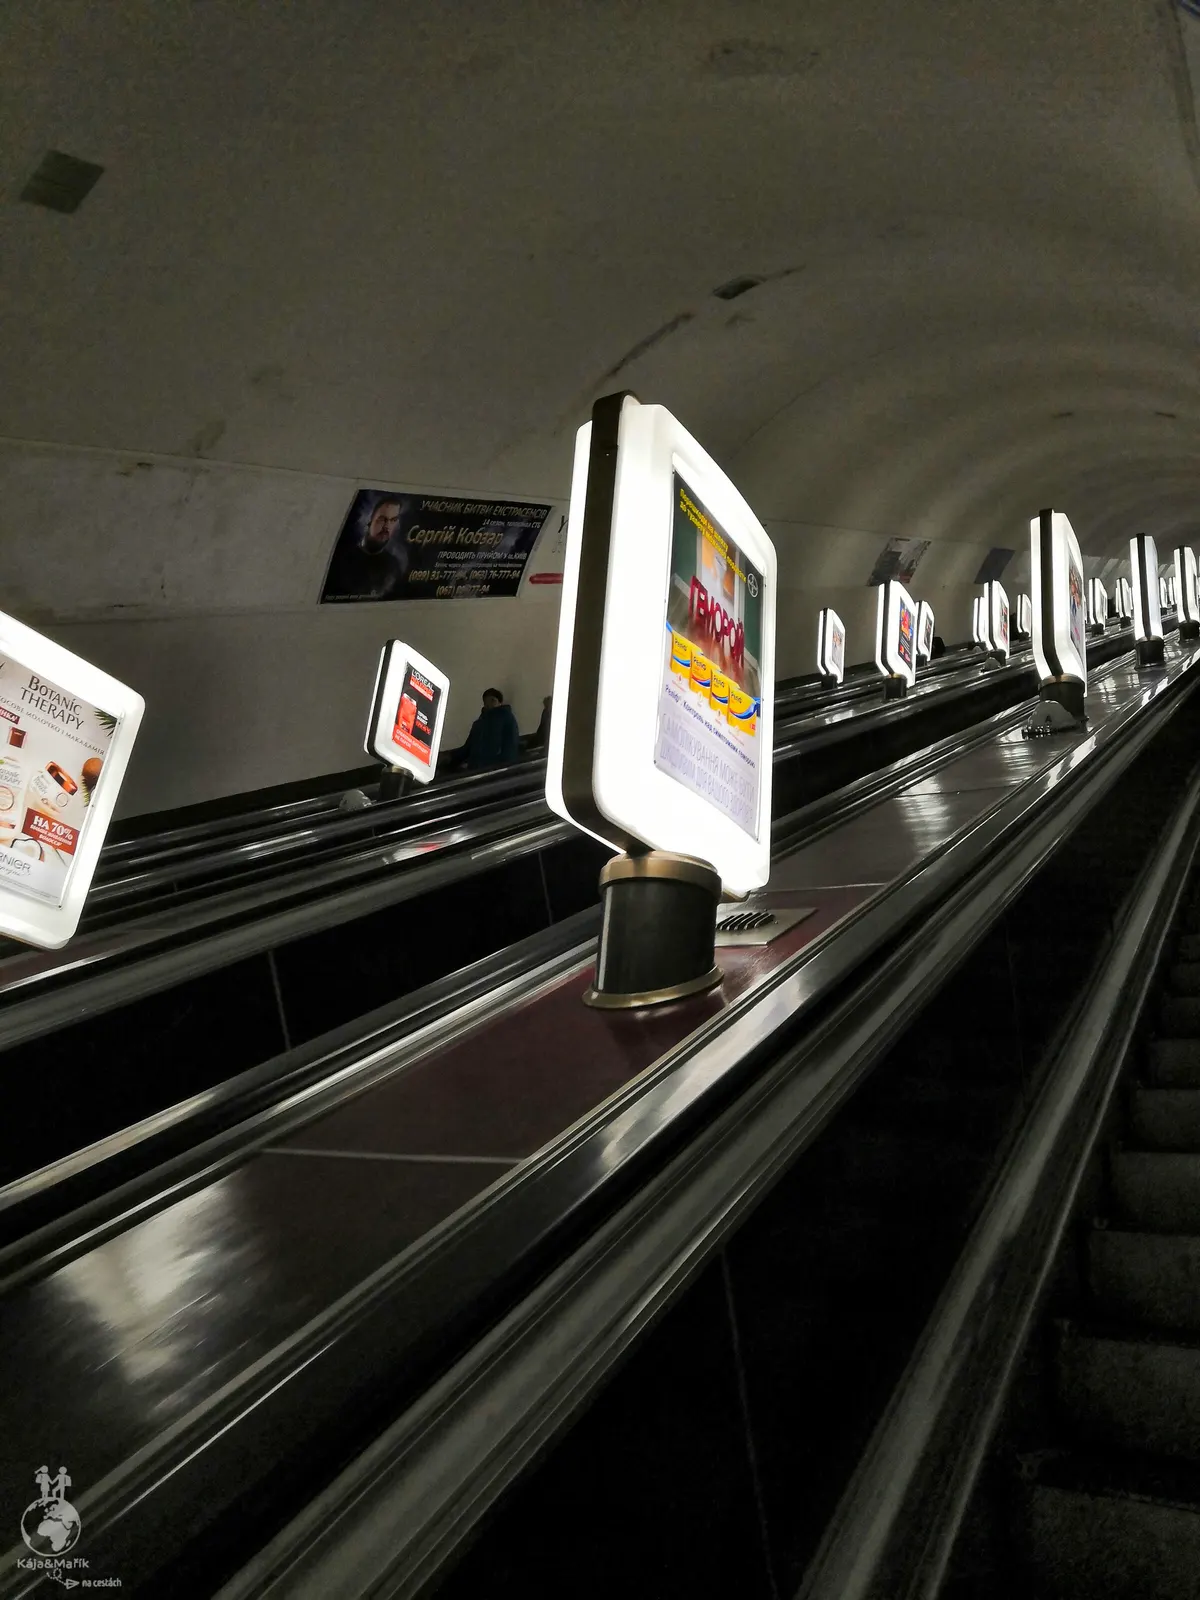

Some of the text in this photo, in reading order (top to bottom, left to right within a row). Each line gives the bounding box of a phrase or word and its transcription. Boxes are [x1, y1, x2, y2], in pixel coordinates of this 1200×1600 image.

[420, 500, 548, 519] УЧАСНИК БИТВИ ЕКСТРАСЕНСІВ
[407, 525, 503, 547] Сергій Кобзар
[438, 551, 476, 560] ПРОВОДИТЬ
[28, 675, 82, 716] BOTANIC
[20, 686, 84, 730] THERAPY
[33, 816, 73, 840] НА 70%
